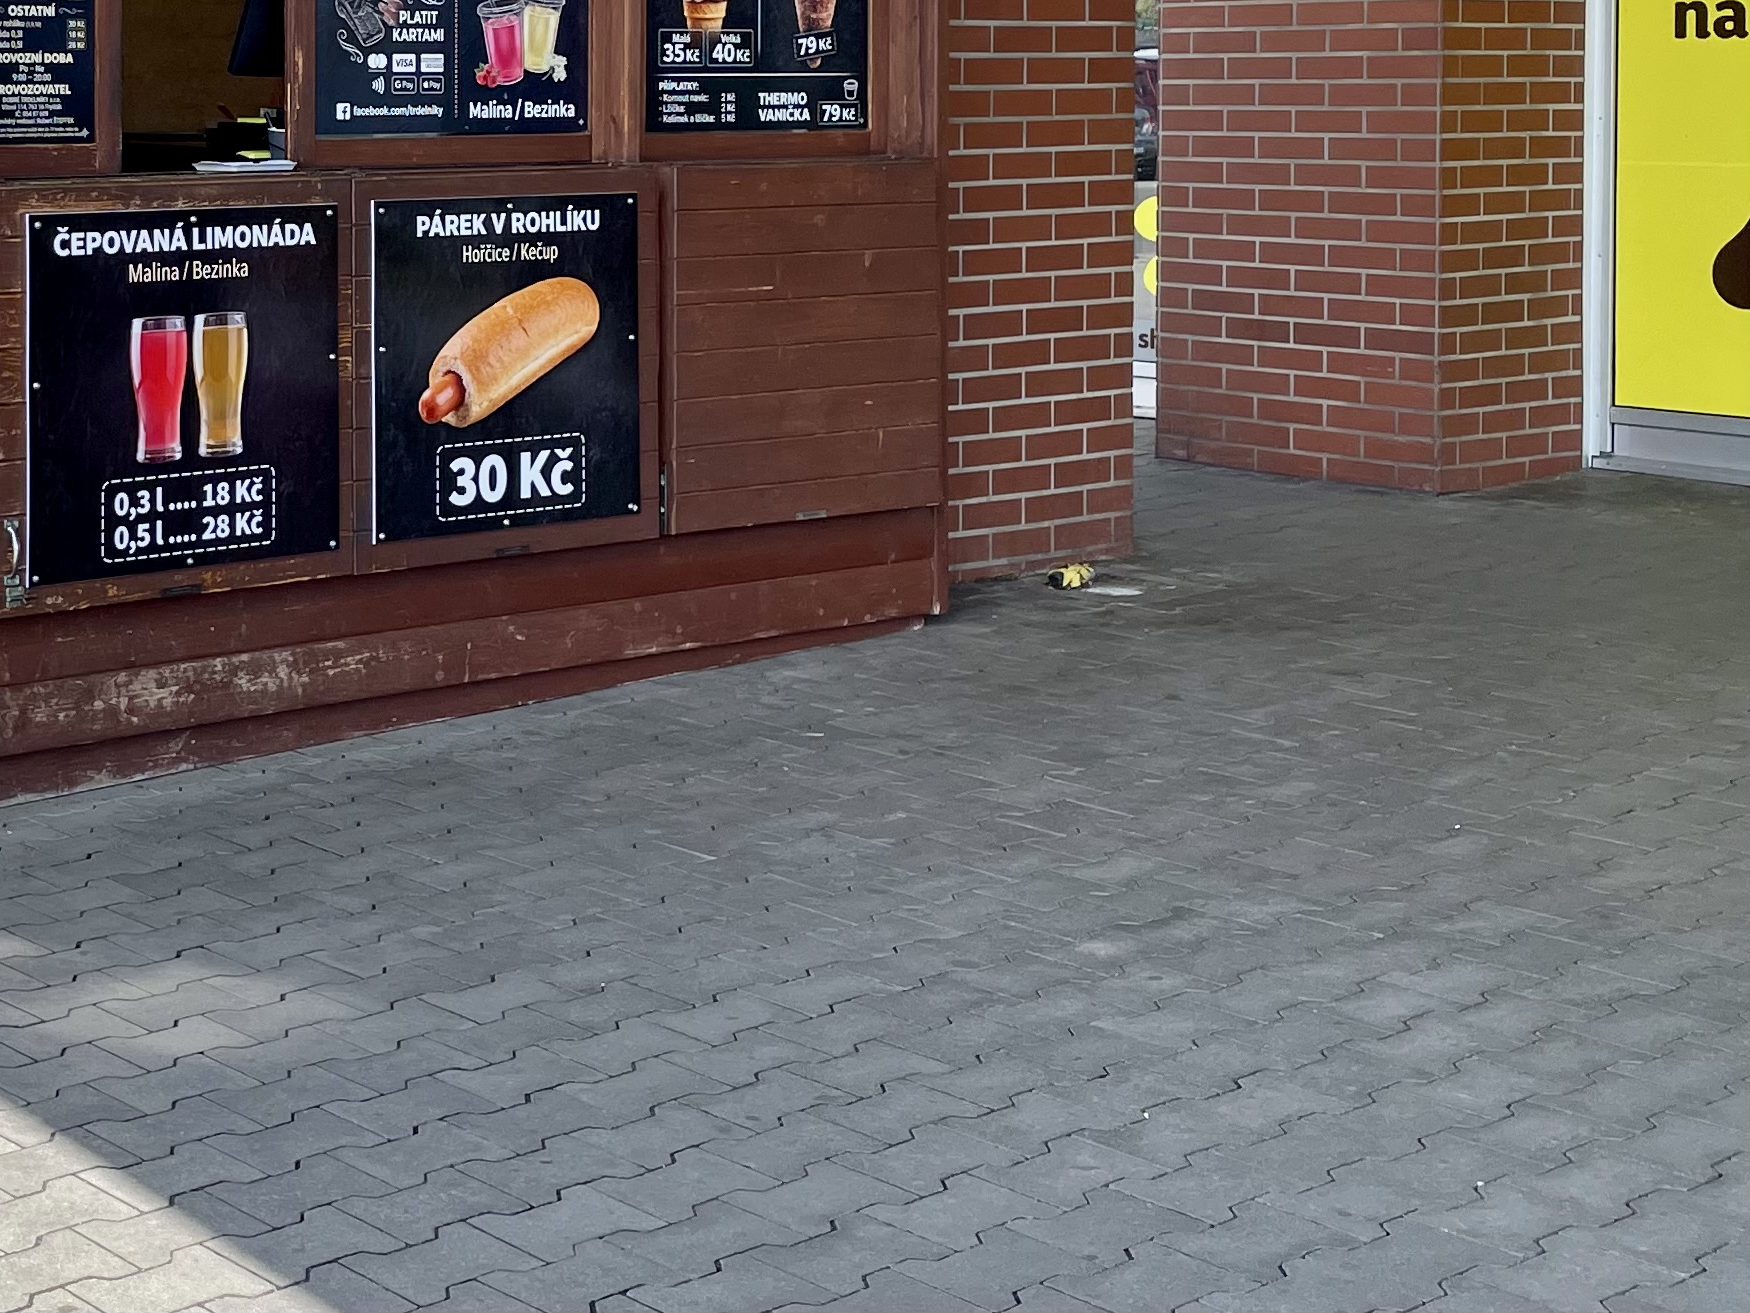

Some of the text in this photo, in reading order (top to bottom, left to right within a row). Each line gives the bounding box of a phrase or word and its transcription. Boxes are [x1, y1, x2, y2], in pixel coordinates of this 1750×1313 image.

[7, 3, 56, 16] OSTATNÍ
[398, 10, 438, 25] PLATIT
[1674, 0, 1750, 40] na
[393, 28, 444, 41] KARTAMI
[671, 33, 691, 43] Malá
[719, 33, 741, 44] Velká
[662, 44, 700, 63] 35 Kč
[712, 44, 750, 63] 40 Kč
[797, 36, 833, 56] 79 Kč
[44, 53, 73, 63] DOBA
[395, 59, 414, 68] VISA
[402, 80, 414, 90] Pay
[429, 80, 441, 90] Pay
[663, 93, 689, 102] Kornout
[758, 92, 807, 107] THERMO
[470, 99, 575, 118] Malina Bezinka
[758, 106, 811, 123] VANIČKA
[821, 104, 856, 122] 79 Kč
[415, 205, 601, 238] PÁREK V ROHLÍKU
[54, 217, 316, 256] ČEPOVANÁ LIMONÁDA
[463, 242, 558, 263] Hořčice Kečup
[129, 259, 248, 283] Malina Bezinka
[449, 447, 574, 506] 30 Kč
[114, 490, 150, 518] 0,3
[203, 482, 230, 506] 18
[236, 477, 263, 503] Kč
[114, 523, 150, 552] 0,5
[202, 517, 230, 540] 28
[236, 512, 263, 536] Kč
